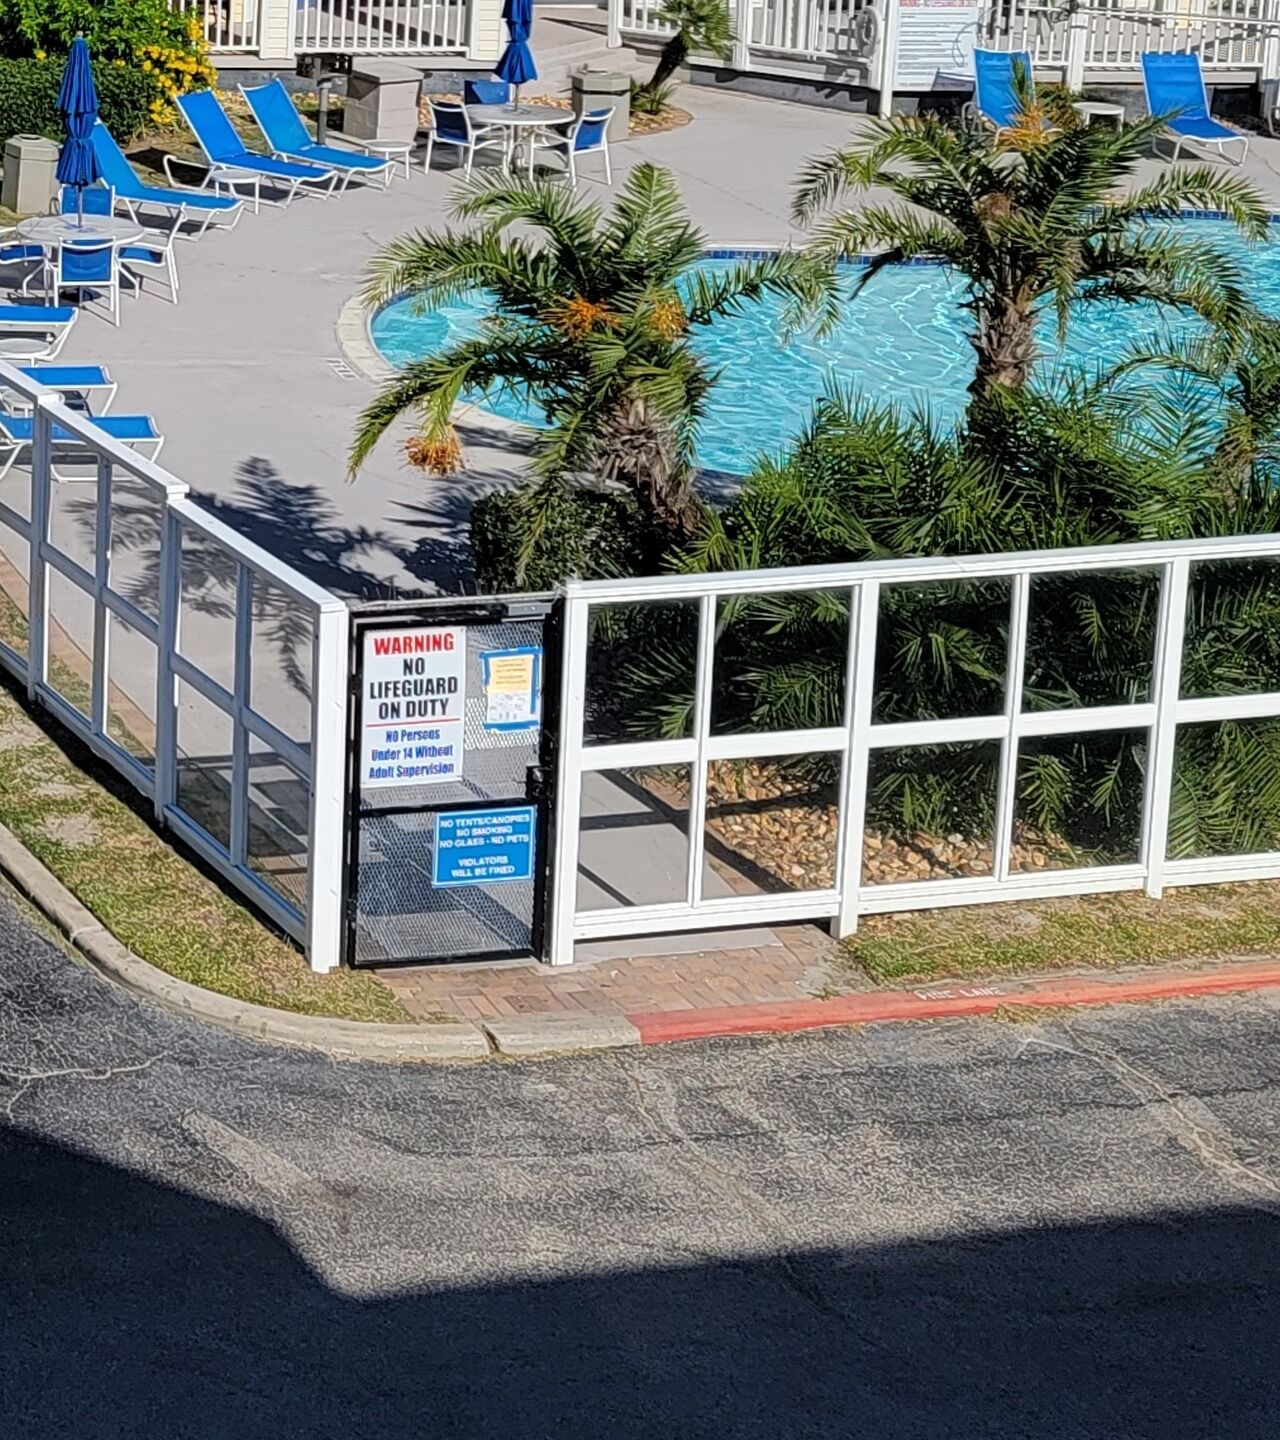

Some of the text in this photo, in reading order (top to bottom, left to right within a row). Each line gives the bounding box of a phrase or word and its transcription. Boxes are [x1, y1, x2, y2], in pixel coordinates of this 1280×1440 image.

[374, 633, 455, 656] WARNING
[403, 657, 425, 676] NO
[369, 676, 458, 699] LIFEGUARD
[378, 698, 449, 720] ON DUTY
[386, 729, 440, 743] NO Persons
[371, 744, 454, 761] Under 14 Without
[369, 763, 454, 779] Adult Supervision
[440, 820, 454, 828] NO
[456, 825, 513, 837] NO SMOKING
[440, 840, 453, 848] NO
[454, 837, 485, 847] GLASS
[490, 836, 504, 844] NO
[506, 834, 529, 843] PETS
[458, 856, 508, 867] VIOLATORS
[451, 865, 515, 877] WILL BE FINED
